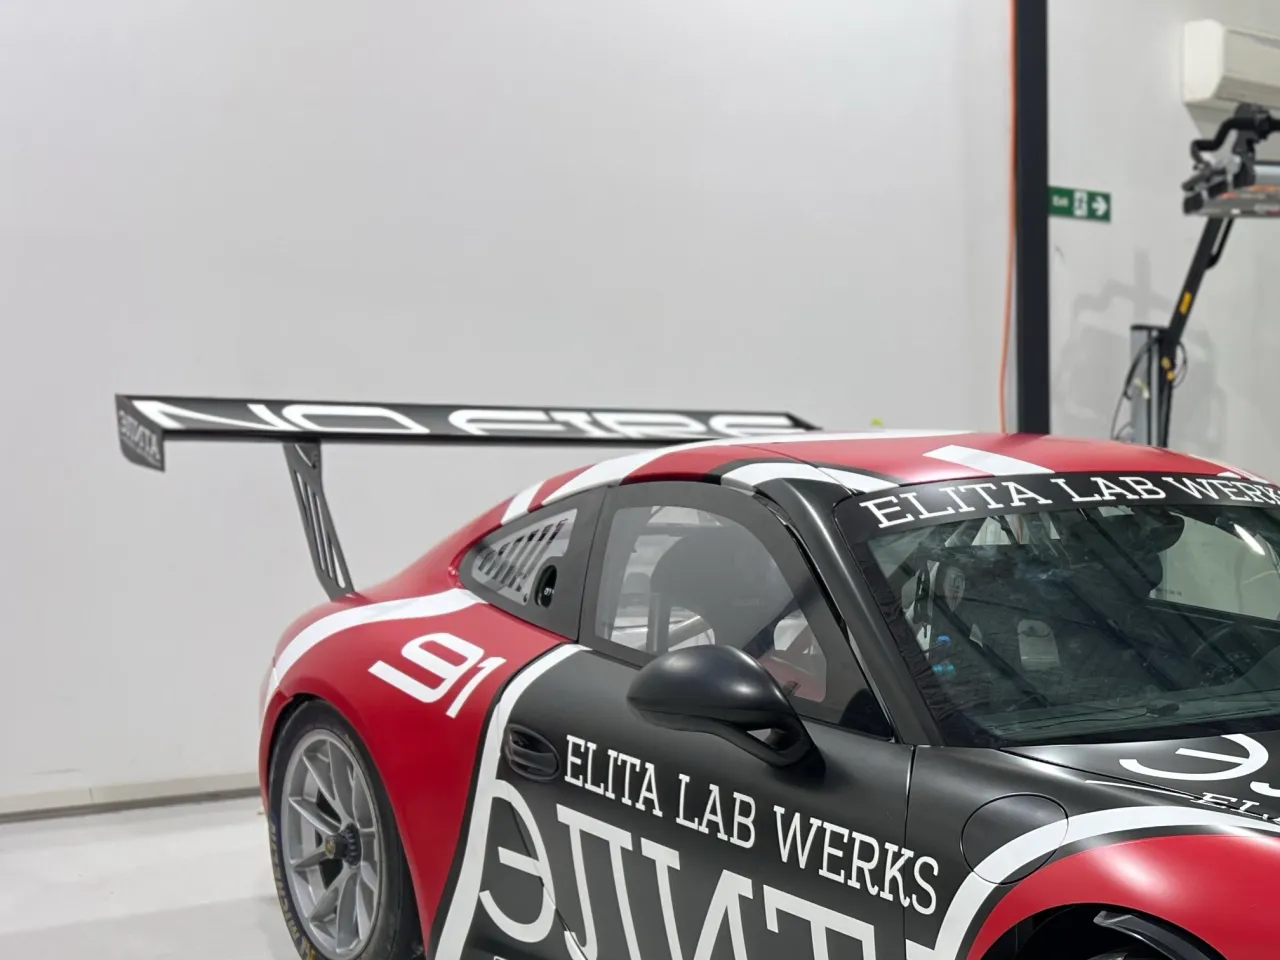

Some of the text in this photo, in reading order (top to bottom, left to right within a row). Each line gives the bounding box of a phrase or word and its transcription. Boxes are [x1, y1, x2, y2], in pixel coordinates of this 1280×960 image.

[859, 481, 1052, 529] ELITA
[1049, 476, 1167, 503] LAB
[368, 632, 507, 719] 91
[564, 734, 940, 916] ELITA LAB WERKS
